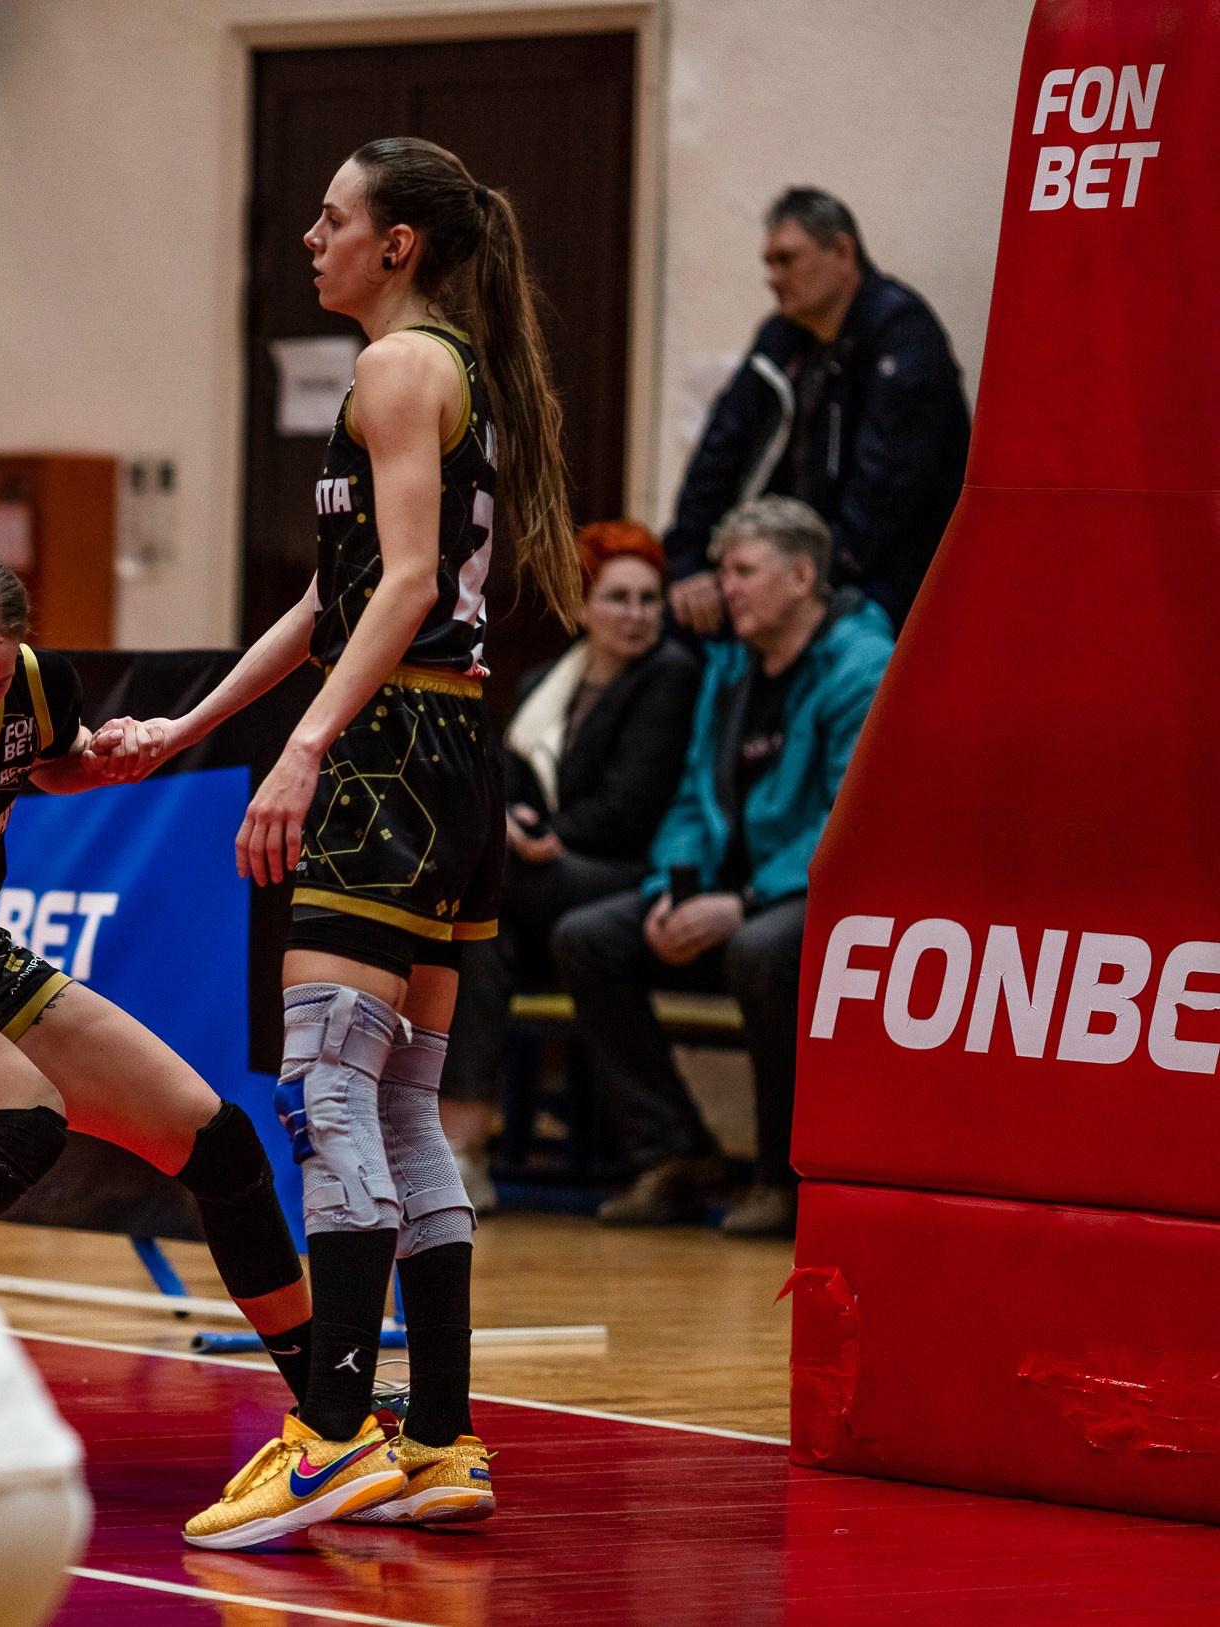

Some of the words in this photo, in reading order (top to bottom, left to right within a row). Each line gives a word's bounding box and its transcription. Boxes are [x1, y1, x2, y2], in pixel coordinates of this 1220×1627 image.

[1032, 64, 1165, 134] FON
[1029, 141, 1160, 211] BET
[809, 914, 1220, 1074] FONBE
